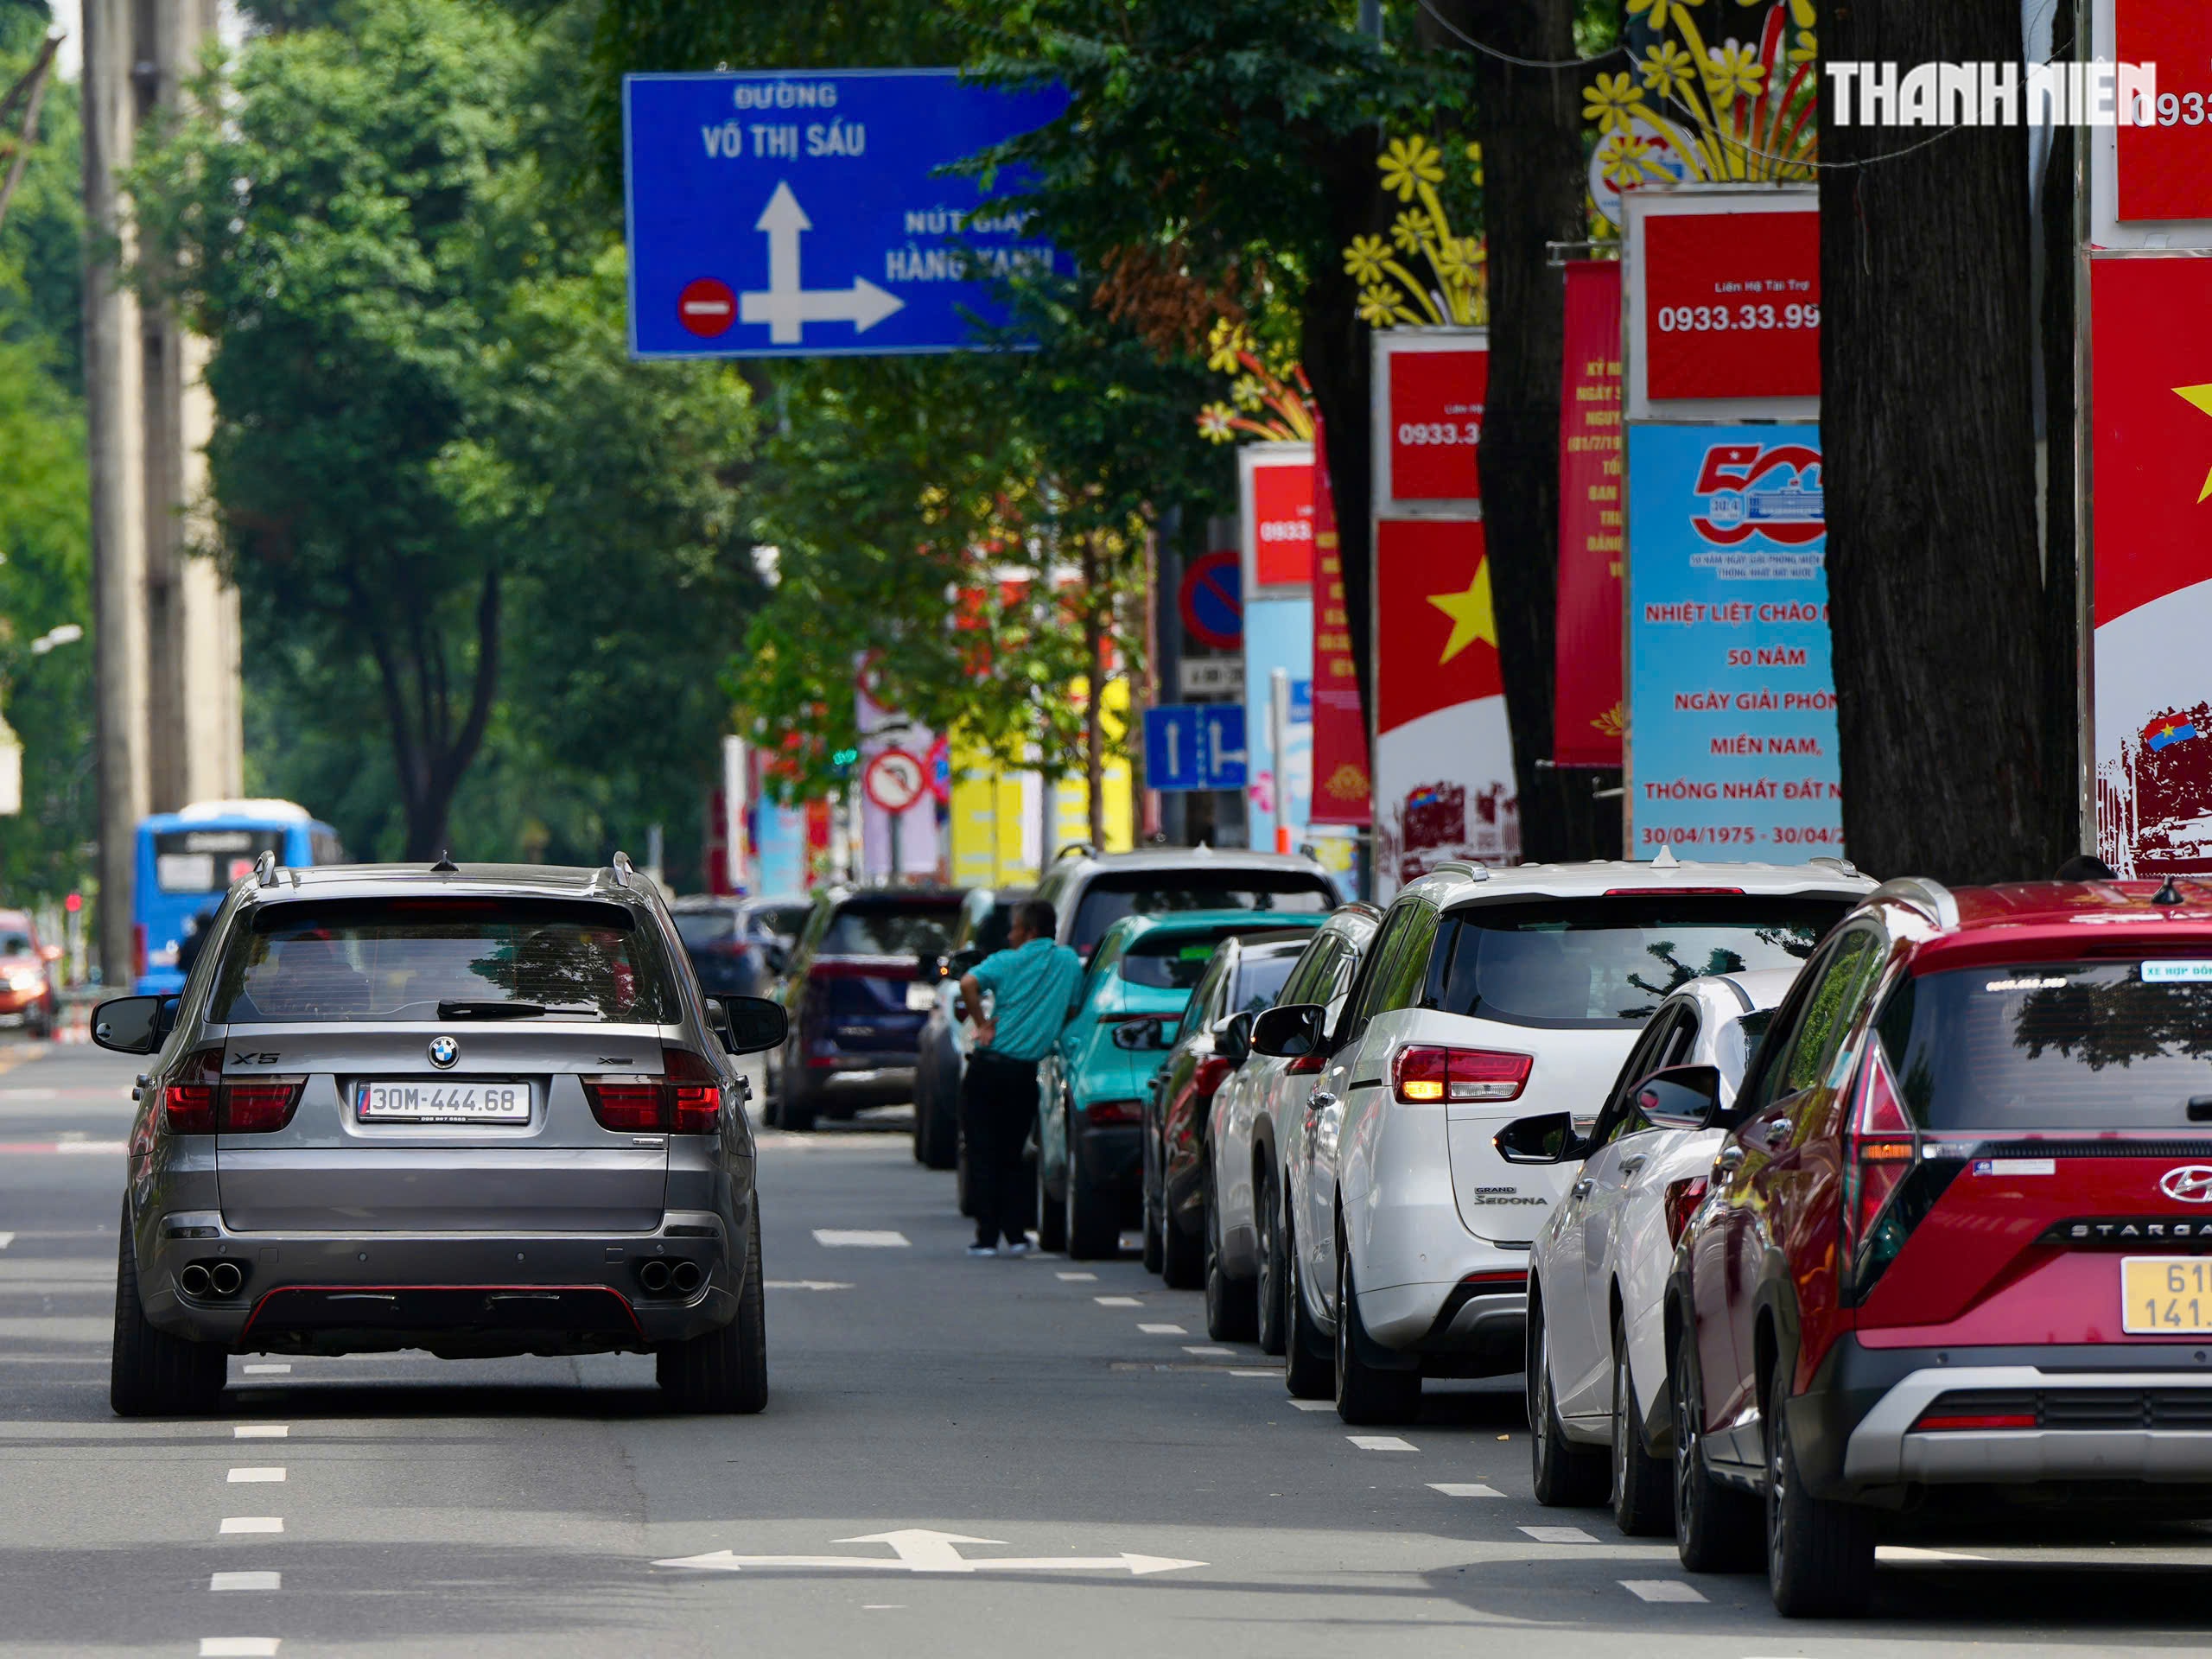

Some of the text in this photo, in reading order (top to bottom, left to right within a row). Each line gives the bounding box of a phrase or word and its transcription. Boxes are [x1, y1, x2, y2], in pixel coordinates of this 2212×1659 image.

[734, 79, 838, 110] ĐƯỜNG
[2132, 92, 2212, 127] 093
[702, 116, 865, 162] VÕ THỊ SÁU
[905, 204, 1039, 234] NÚT GIA
[886, 241, 967, 282] HÀNG
[1657, 303, 1821, 332] 0933.33.99
[1399, 422, 1480, 445] 0933.3
[1645, 600, 1706, 626] NHIỆT
[1711, 601, 1753, 626] LIỆT
[1758, 600, 1818, 622] CHÀO
[1727, 645, 1807, 666] 50 NĂM
[1675, 690, 1732, 712] NGÀY
[1736, 687, 1779, 711] GIẢI
[1711, 733, 1764, 754] MIỀN
[1643, 775, 1719, 799] THỐNG
[1723, 775, 1779, 799] NHẤT
[1783, 777, 1824, 799] ĐẤT
[1643, 825, 1755, 844] 30/04/1975
[230, 1052, 281, 1065] X5
[372, 1088, 516, 1112] 30M-444.68
[1474, 1195, 1548, 1205] SEDONA
[2167, 1264, 2212, 1293] 61
